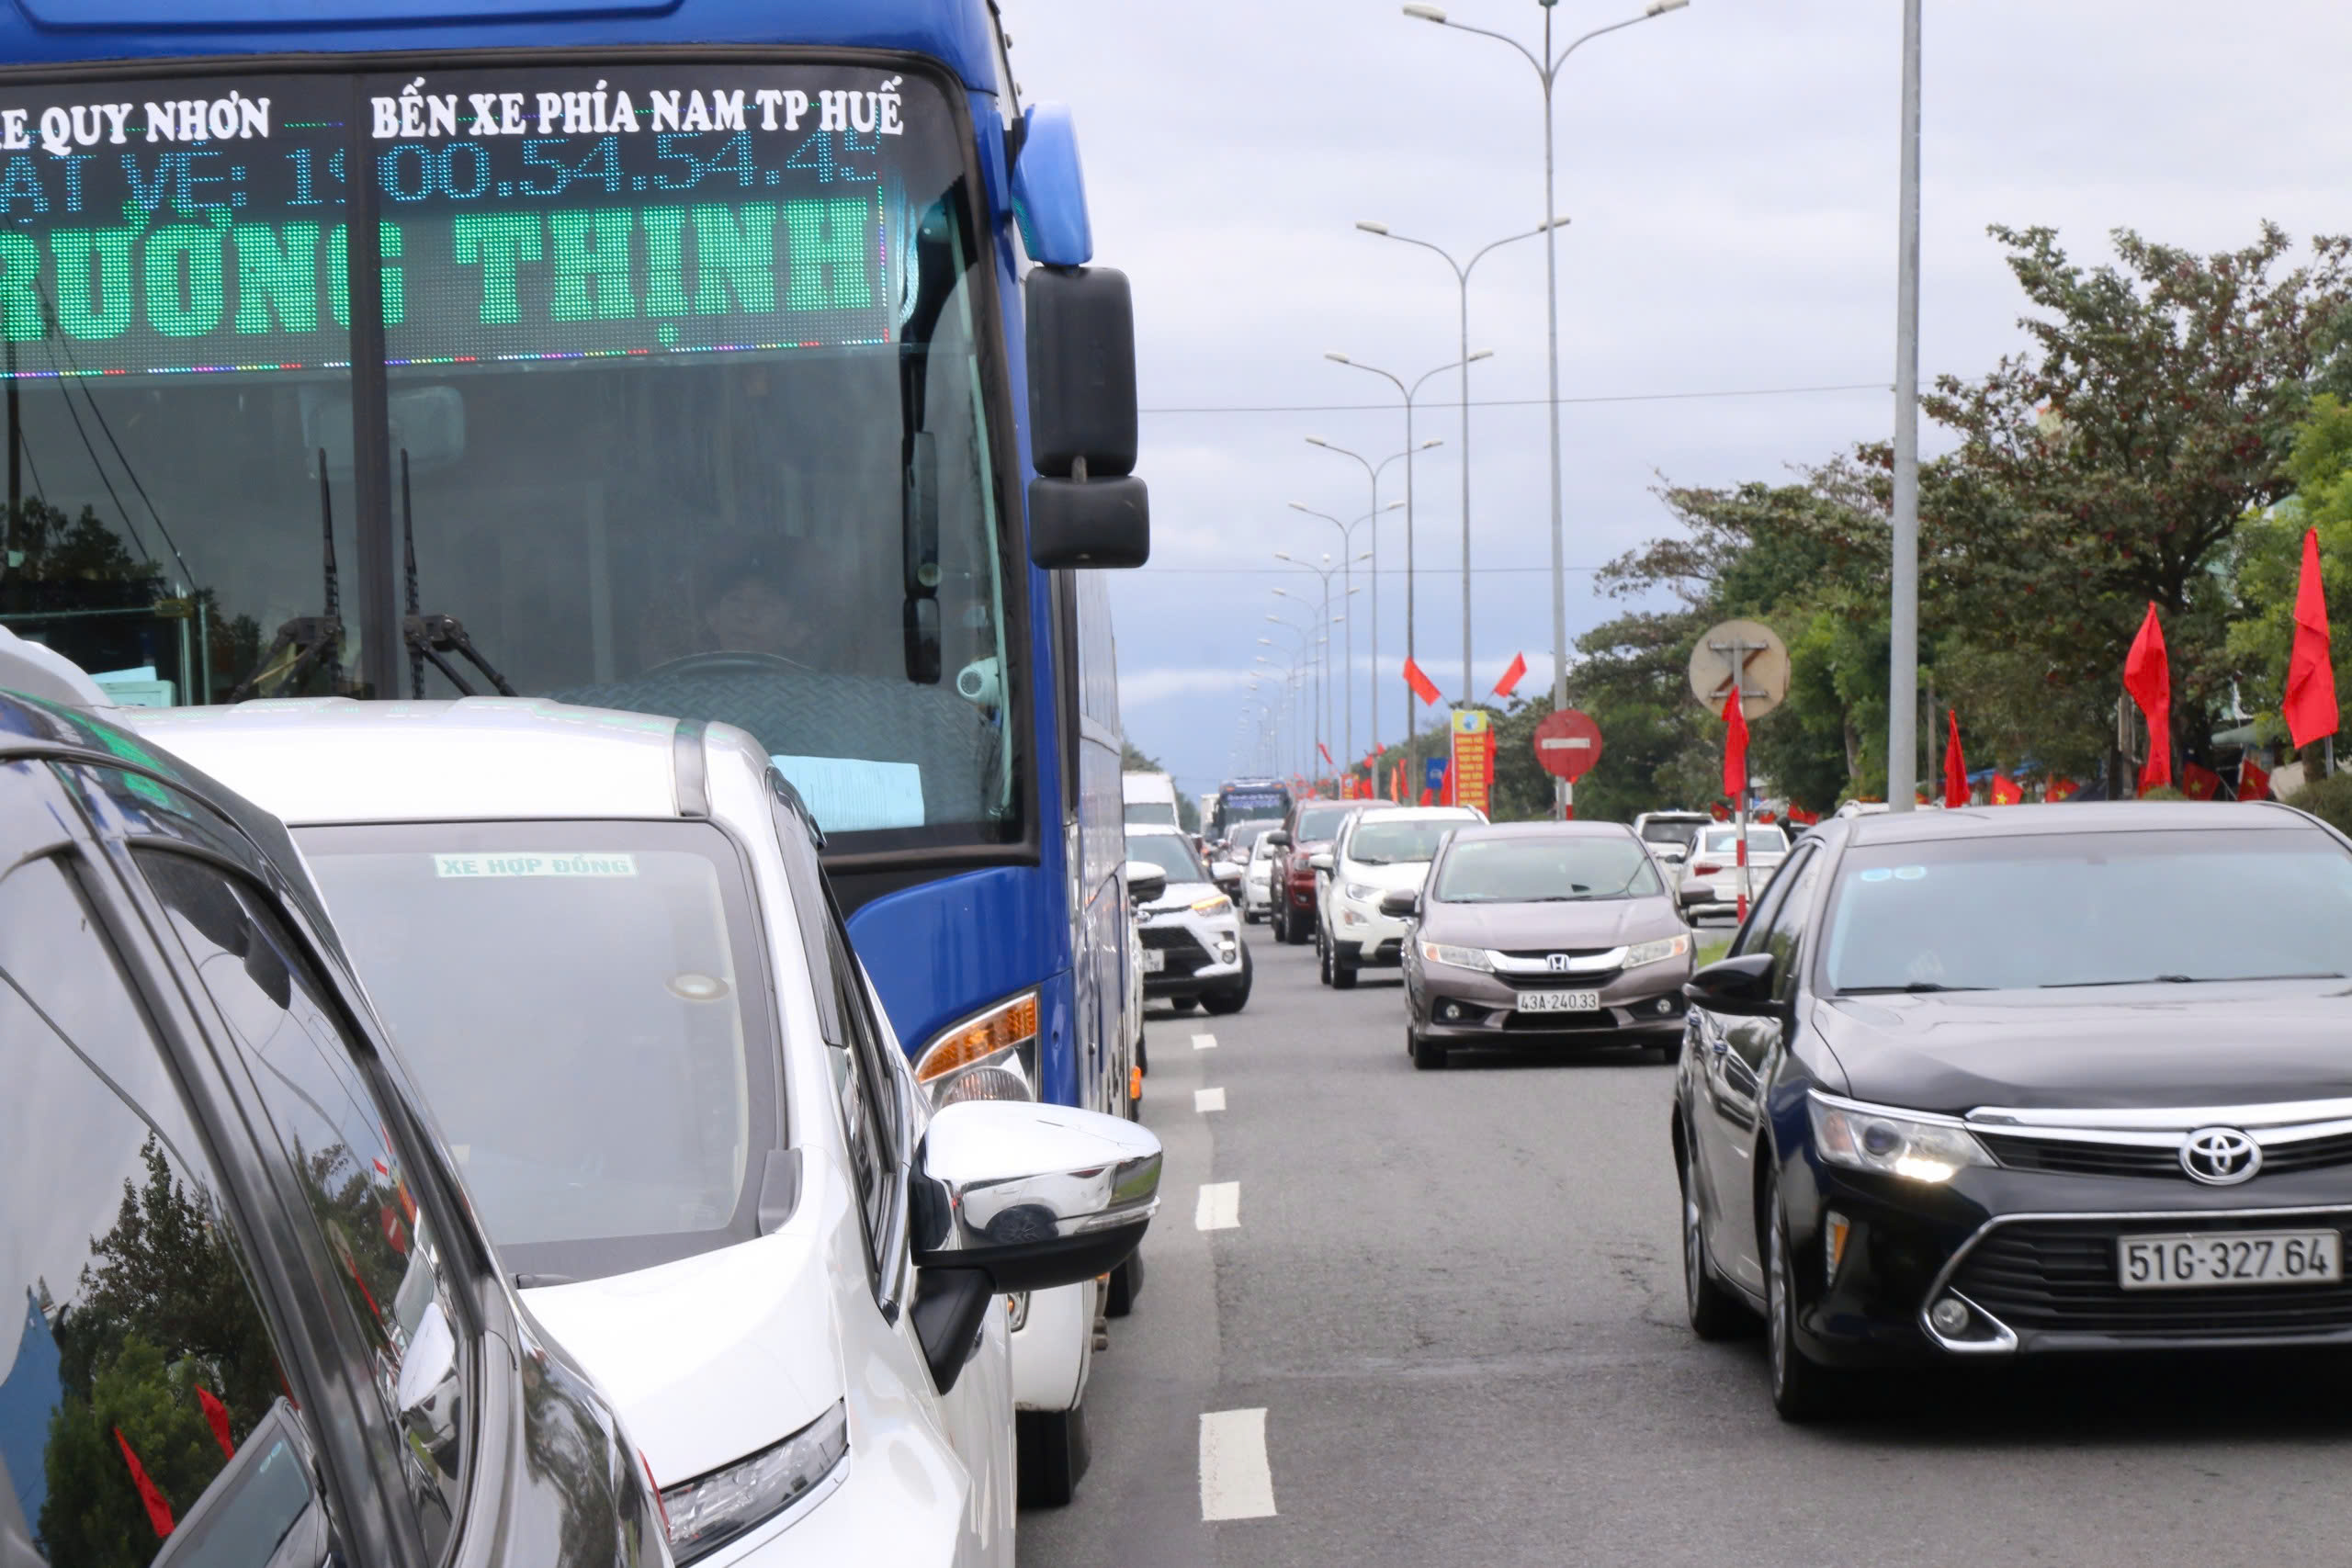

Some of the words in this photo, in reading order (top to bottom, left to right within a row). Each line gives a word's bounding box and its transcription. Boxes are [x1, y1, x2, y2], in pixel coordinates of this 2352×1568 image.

[0, 108, 30, 150] E
[40, 104, 133, 156] QUY
[144, 90, 270, 143] NHƠN
[371, 76, 458, 138] BẾN
[468, 93, 527, 136] XE
[536, 79, 640, 134] PHÍA
[650, 90, 745, 132] NAM
[755, 89, 808, 131] TP
[819, 75, 904, 135] HUẾ
[453, 197, 871, 348] THỊNH
[442, 860, 479, 874] XE
[2128, 1238, 2329, 1281] 51G-327.64
